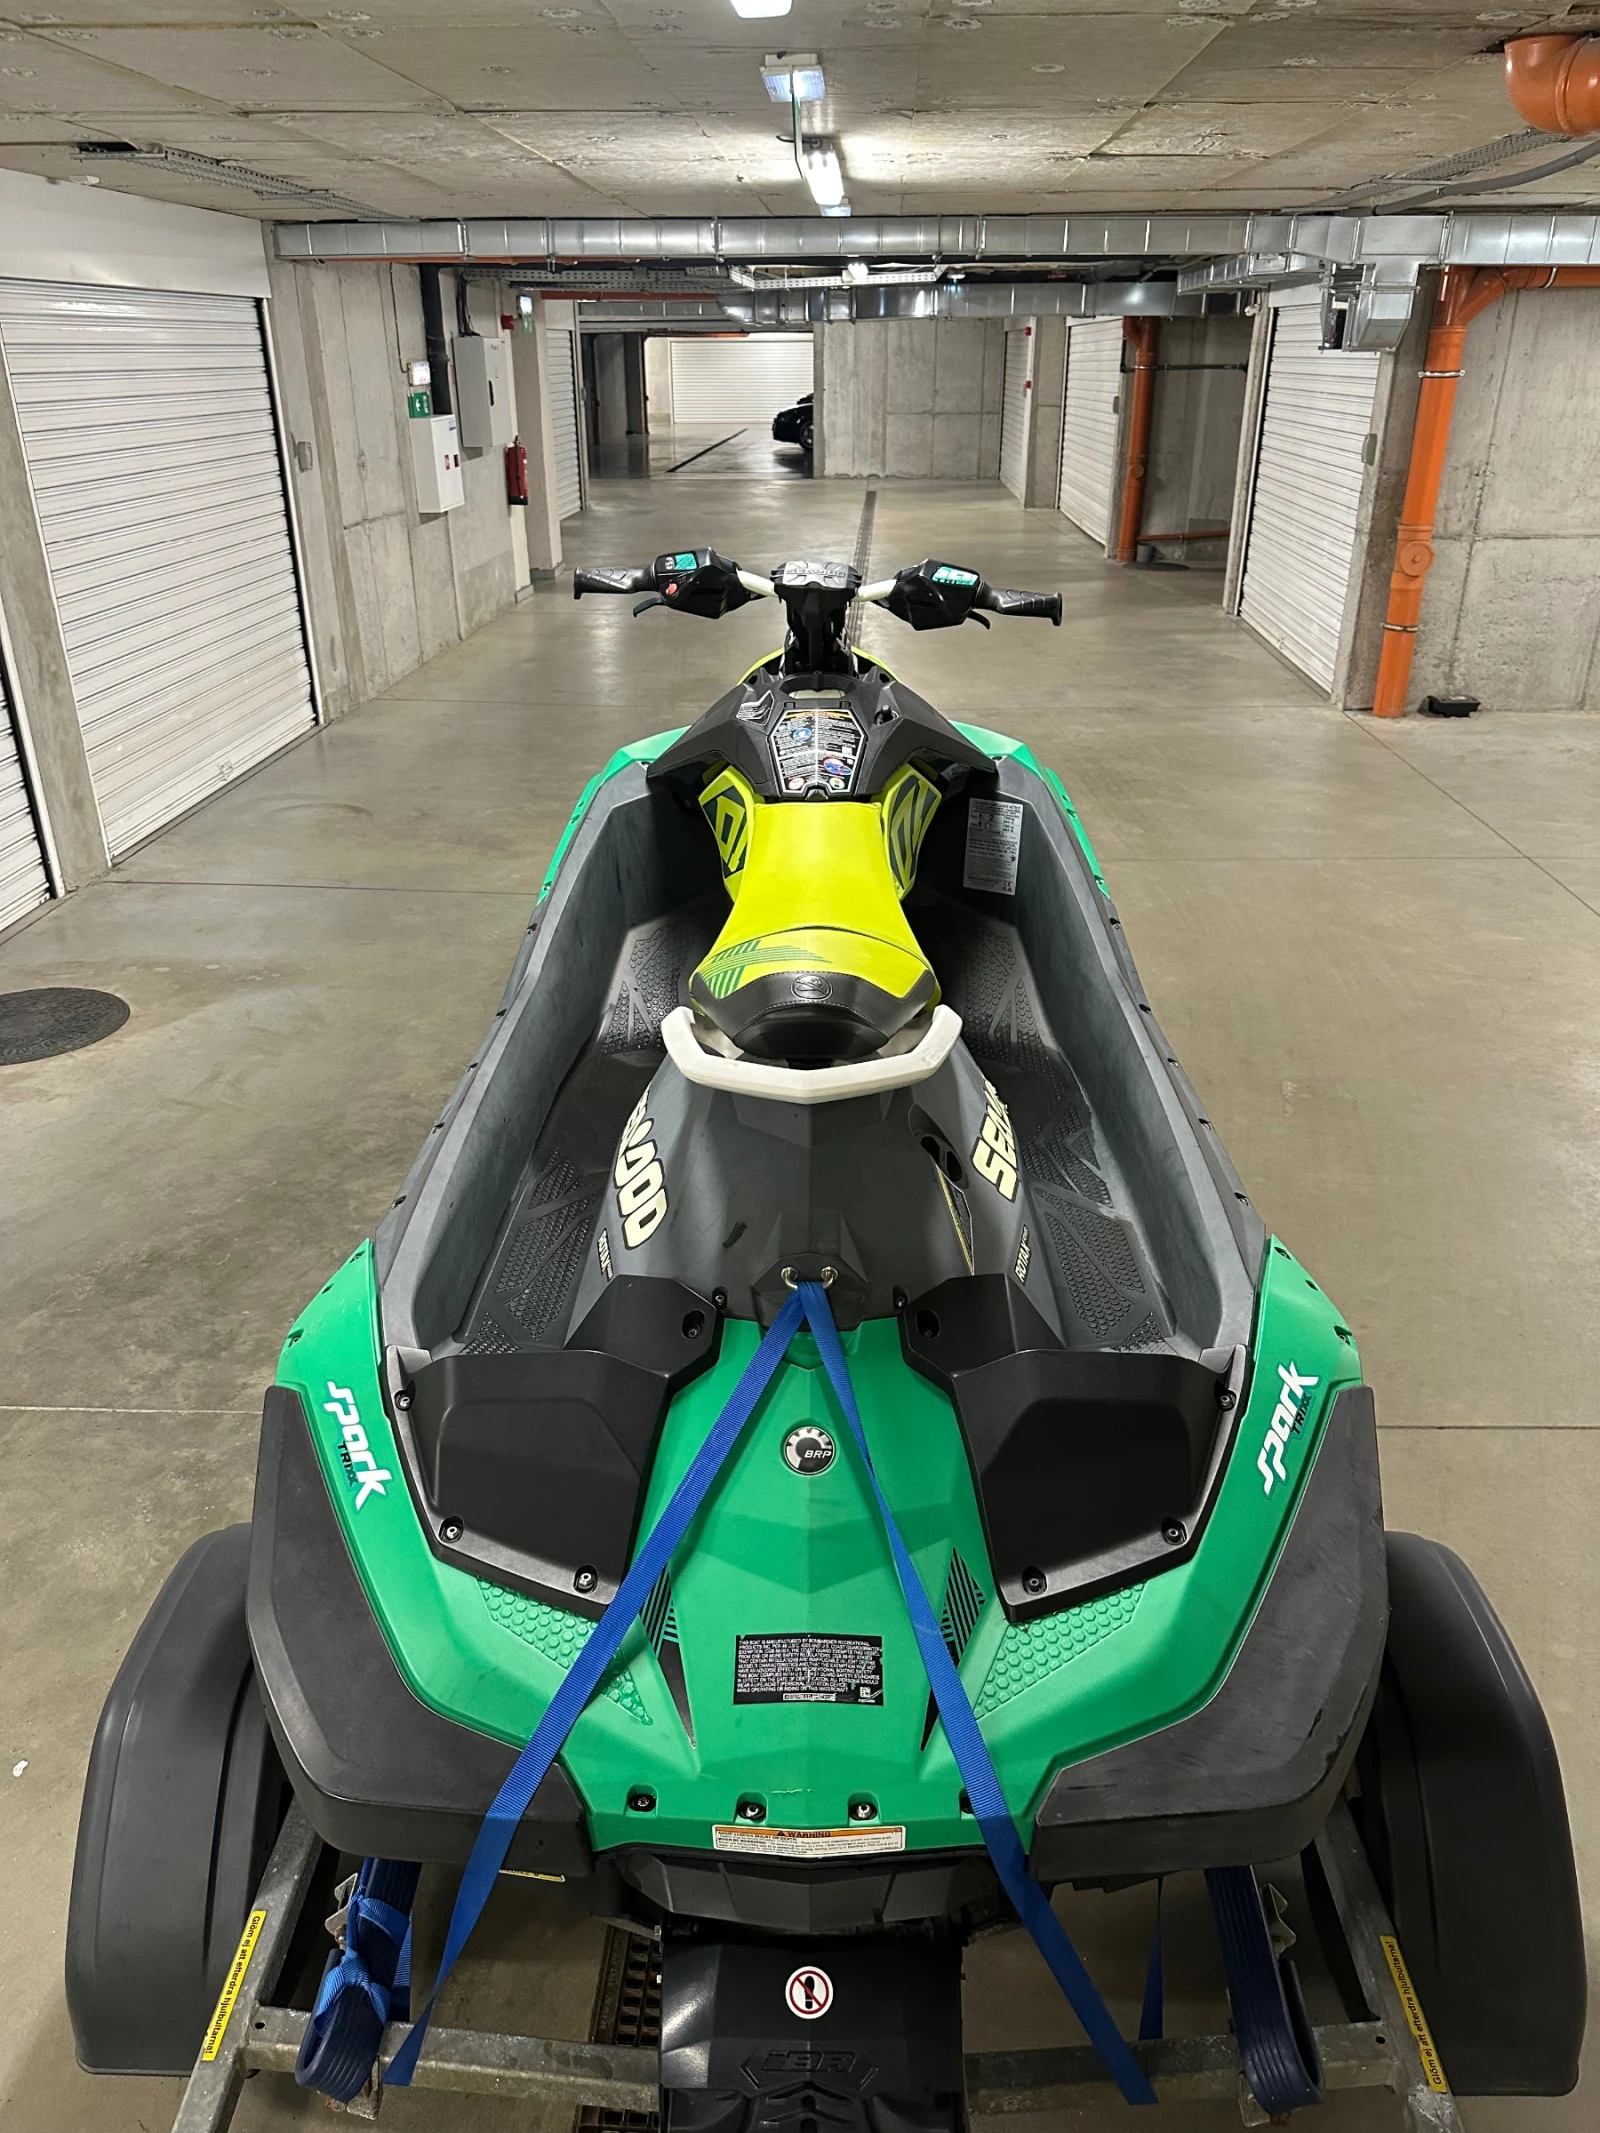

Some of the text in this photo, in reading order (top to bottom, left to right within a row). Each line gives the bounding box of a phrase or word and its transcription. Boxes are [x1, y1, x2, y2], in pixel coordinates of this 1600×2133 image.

[1014, 1238, 1030, 1283] ROTAX
[804, 1450, 832, 1459] BRP
[247, 1916, 260, 1938] Glöm
[238, 1948, 247, 1960] att
[226, 1962, 243, 1995] efterdra
[205, 1997, 231, 2054] hjulbultarna!
[1386, 1941, 1441, 2085] Glöm ej att efterdra hjulbultarna!
